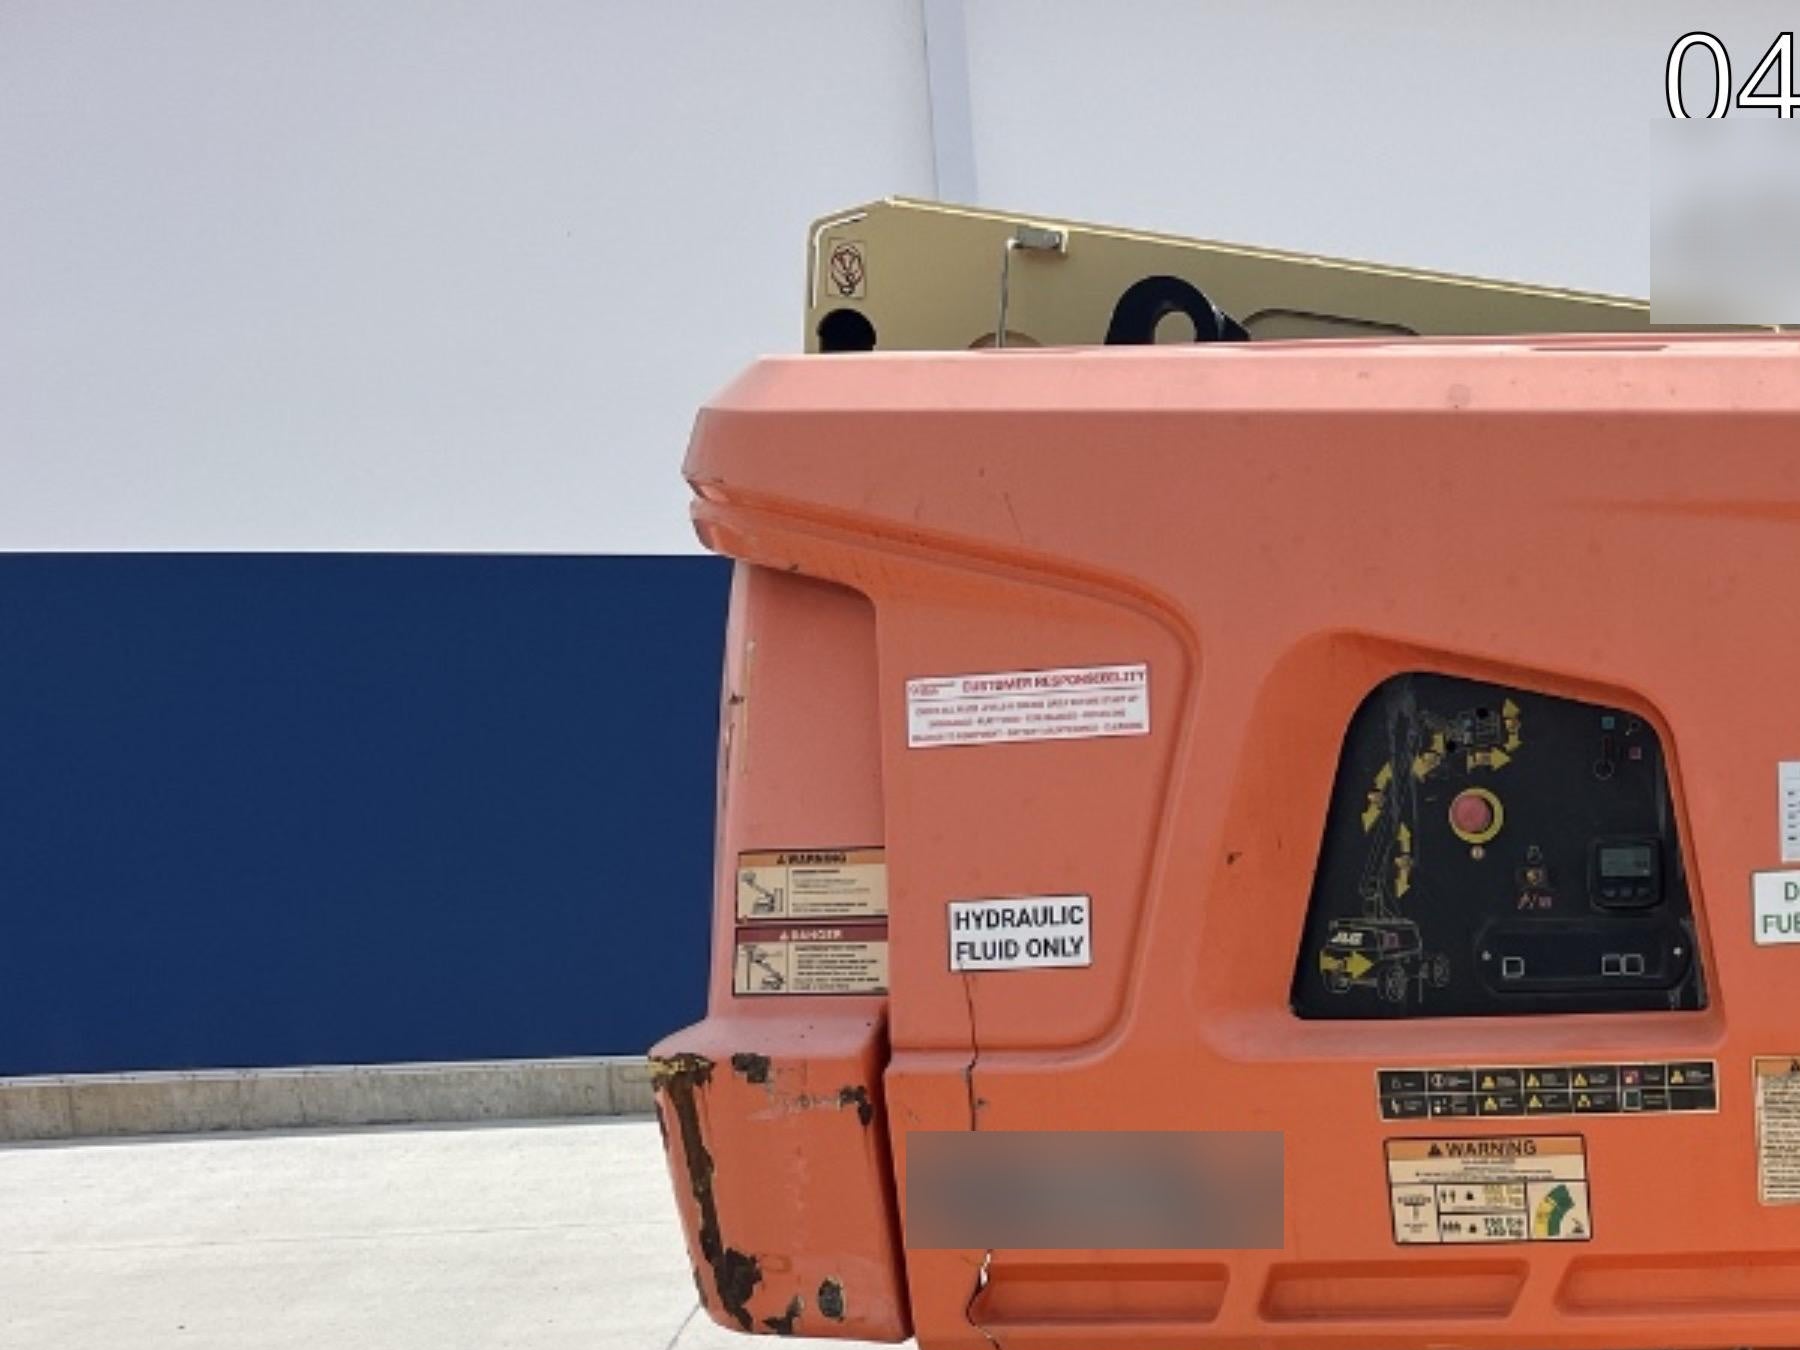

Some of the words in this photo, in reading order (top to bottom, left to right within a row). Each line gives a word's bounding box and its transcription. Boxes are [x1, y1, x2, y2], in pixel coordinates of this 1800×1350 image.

[953, 905, 1085, 931] HYDRAULIC
[955, 938, 1020, 962] FLUID
[1027, 935, 1084, 959] ONLY
[1445, 1139, 1537, 1158] WARNING
